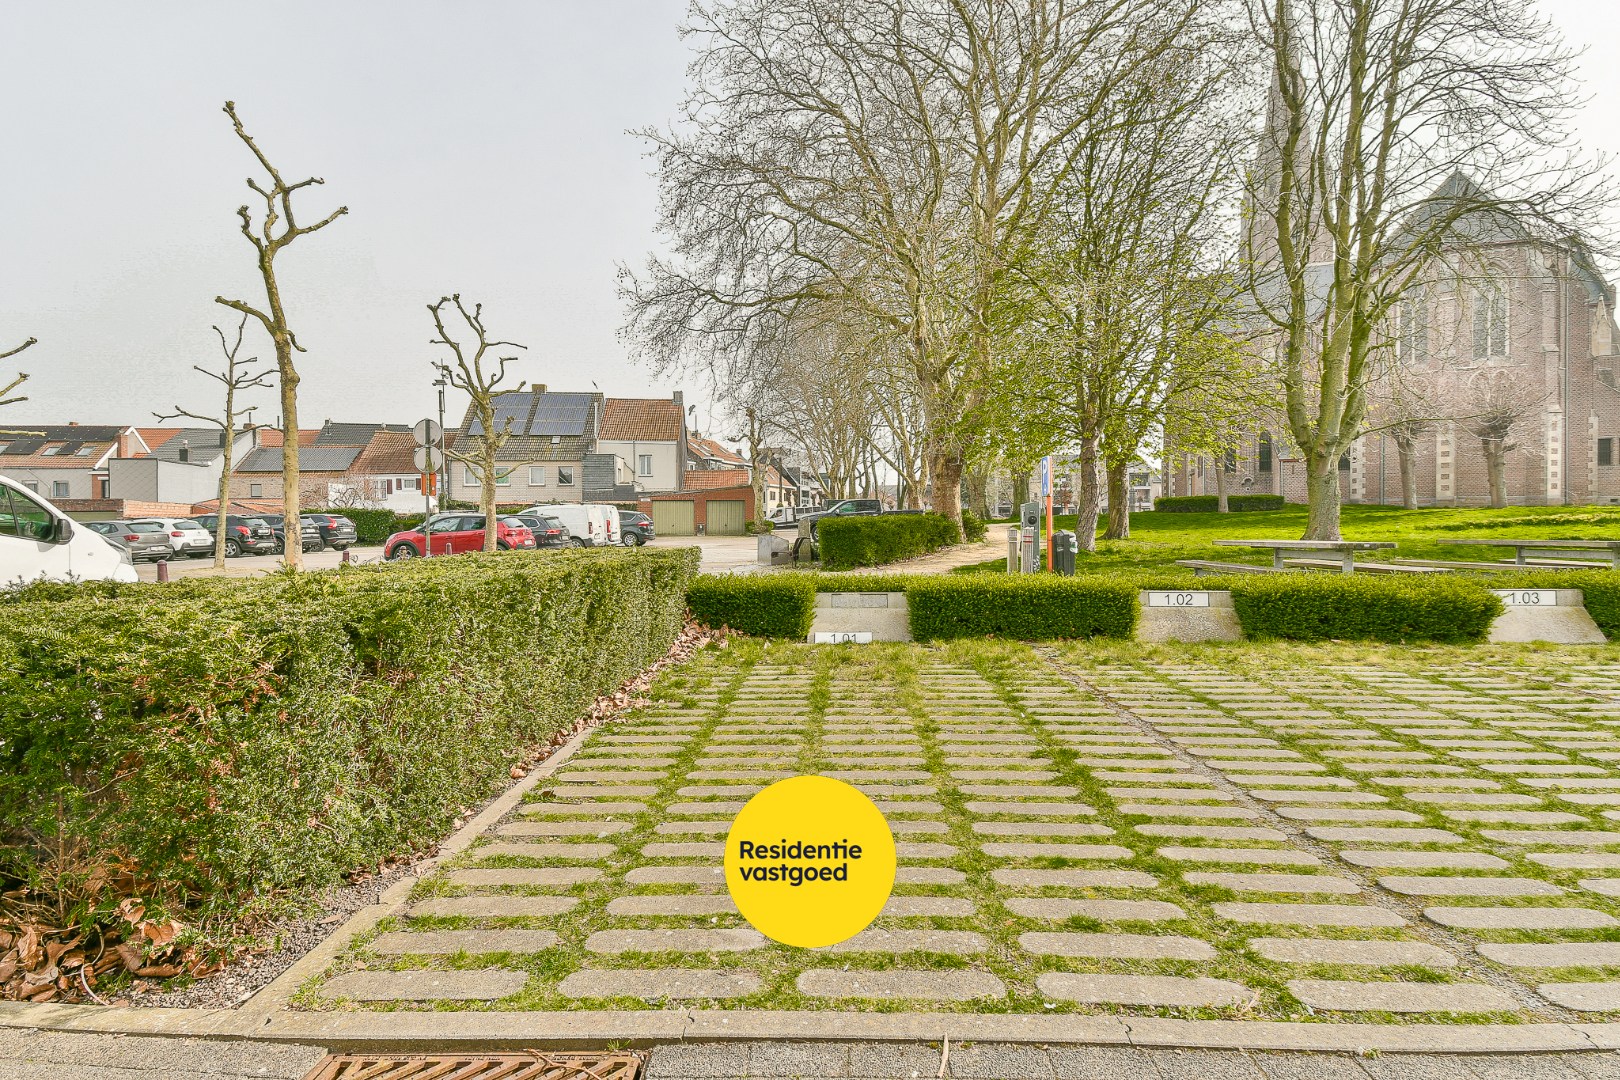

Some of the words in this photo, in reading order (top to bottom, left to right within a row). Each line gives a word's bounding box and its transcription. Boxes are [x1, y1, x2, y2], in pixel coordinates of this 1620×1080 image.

[1164, 593, 1194, 606] 1.02
[1510, 592, 1540, 604] 1.03
[830, 633, 858, 643] 101
